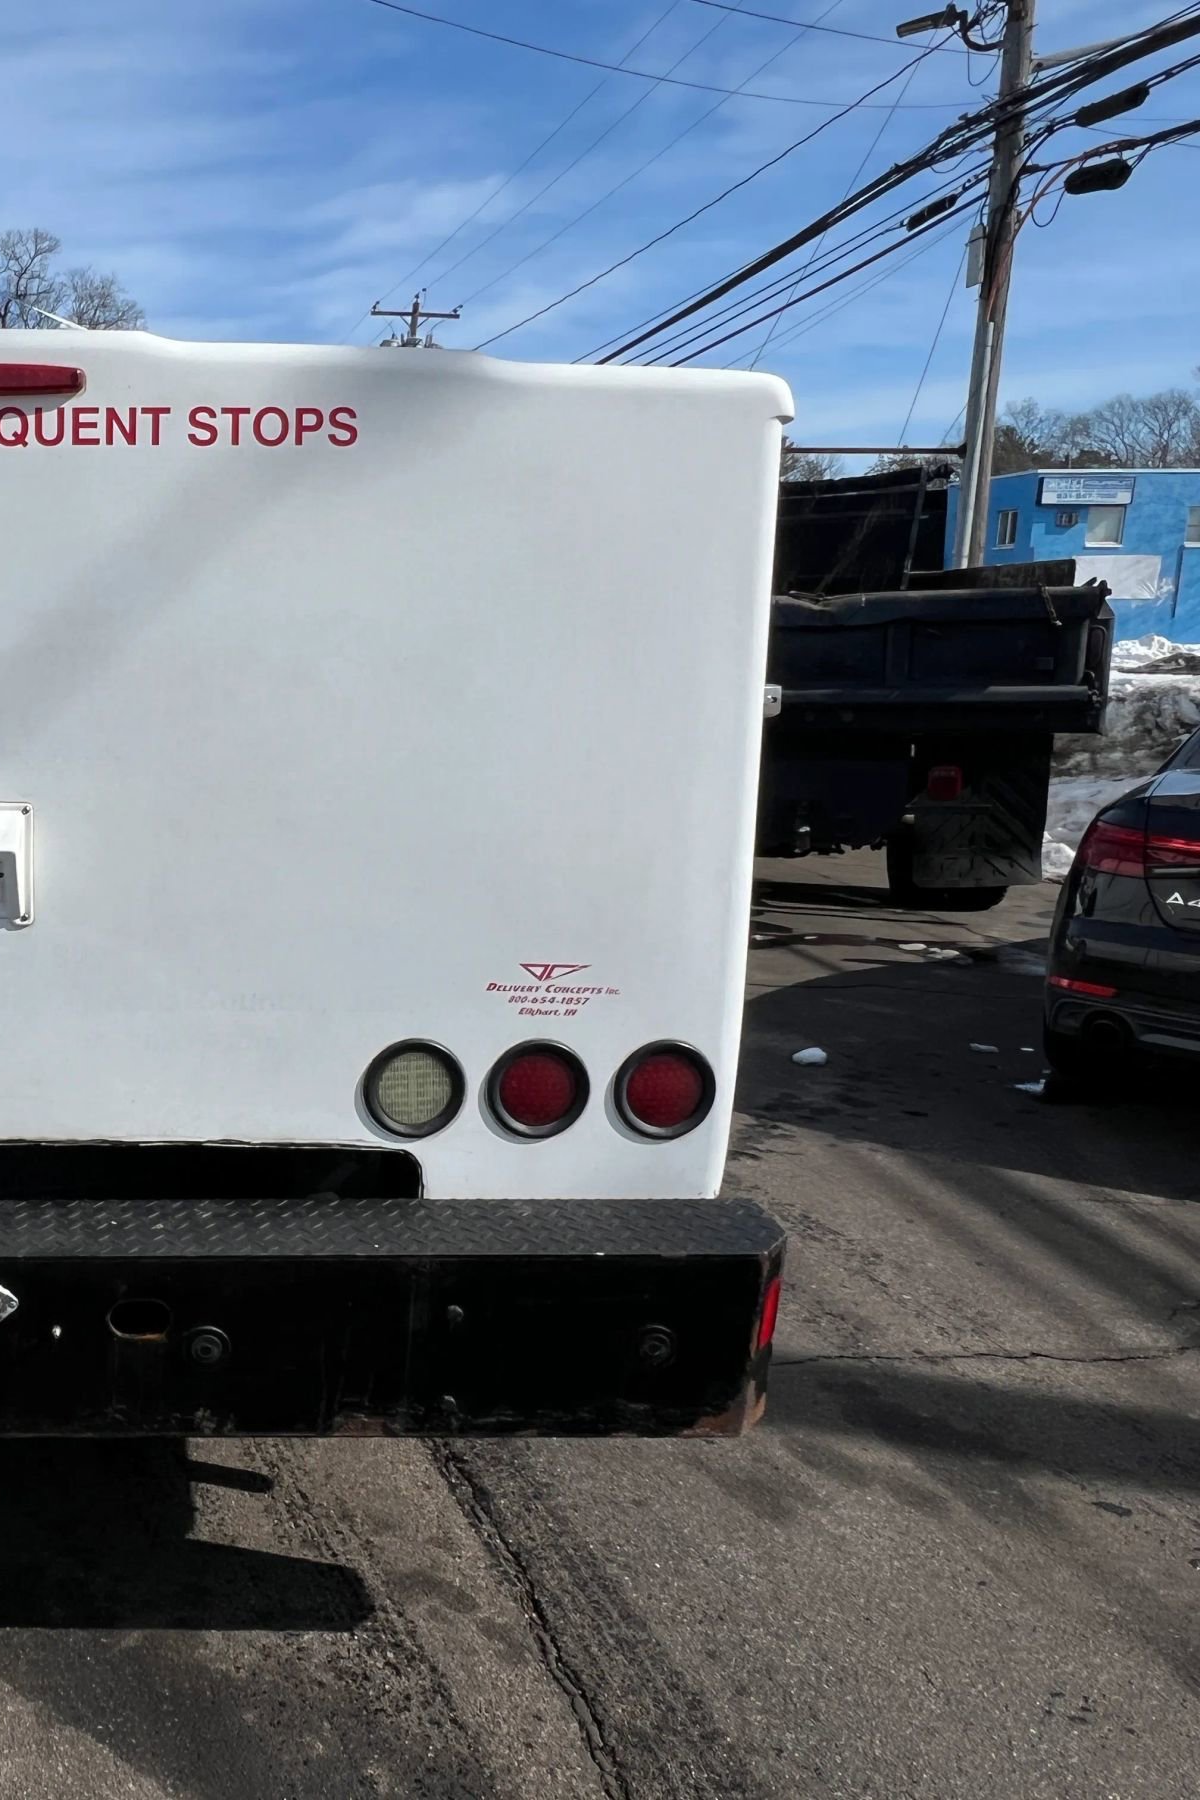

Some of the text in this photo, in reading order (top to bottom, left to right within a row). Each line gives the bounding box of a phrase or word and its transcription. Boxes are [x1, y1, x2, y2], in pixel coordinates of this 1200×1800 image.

[186, 406, 359, 447] STOPS
[486, 982, 542, 993] DELIVERY
[544, 984, 604, 995] CONCEPTS
[563, 1008, 578, 1017] IN
